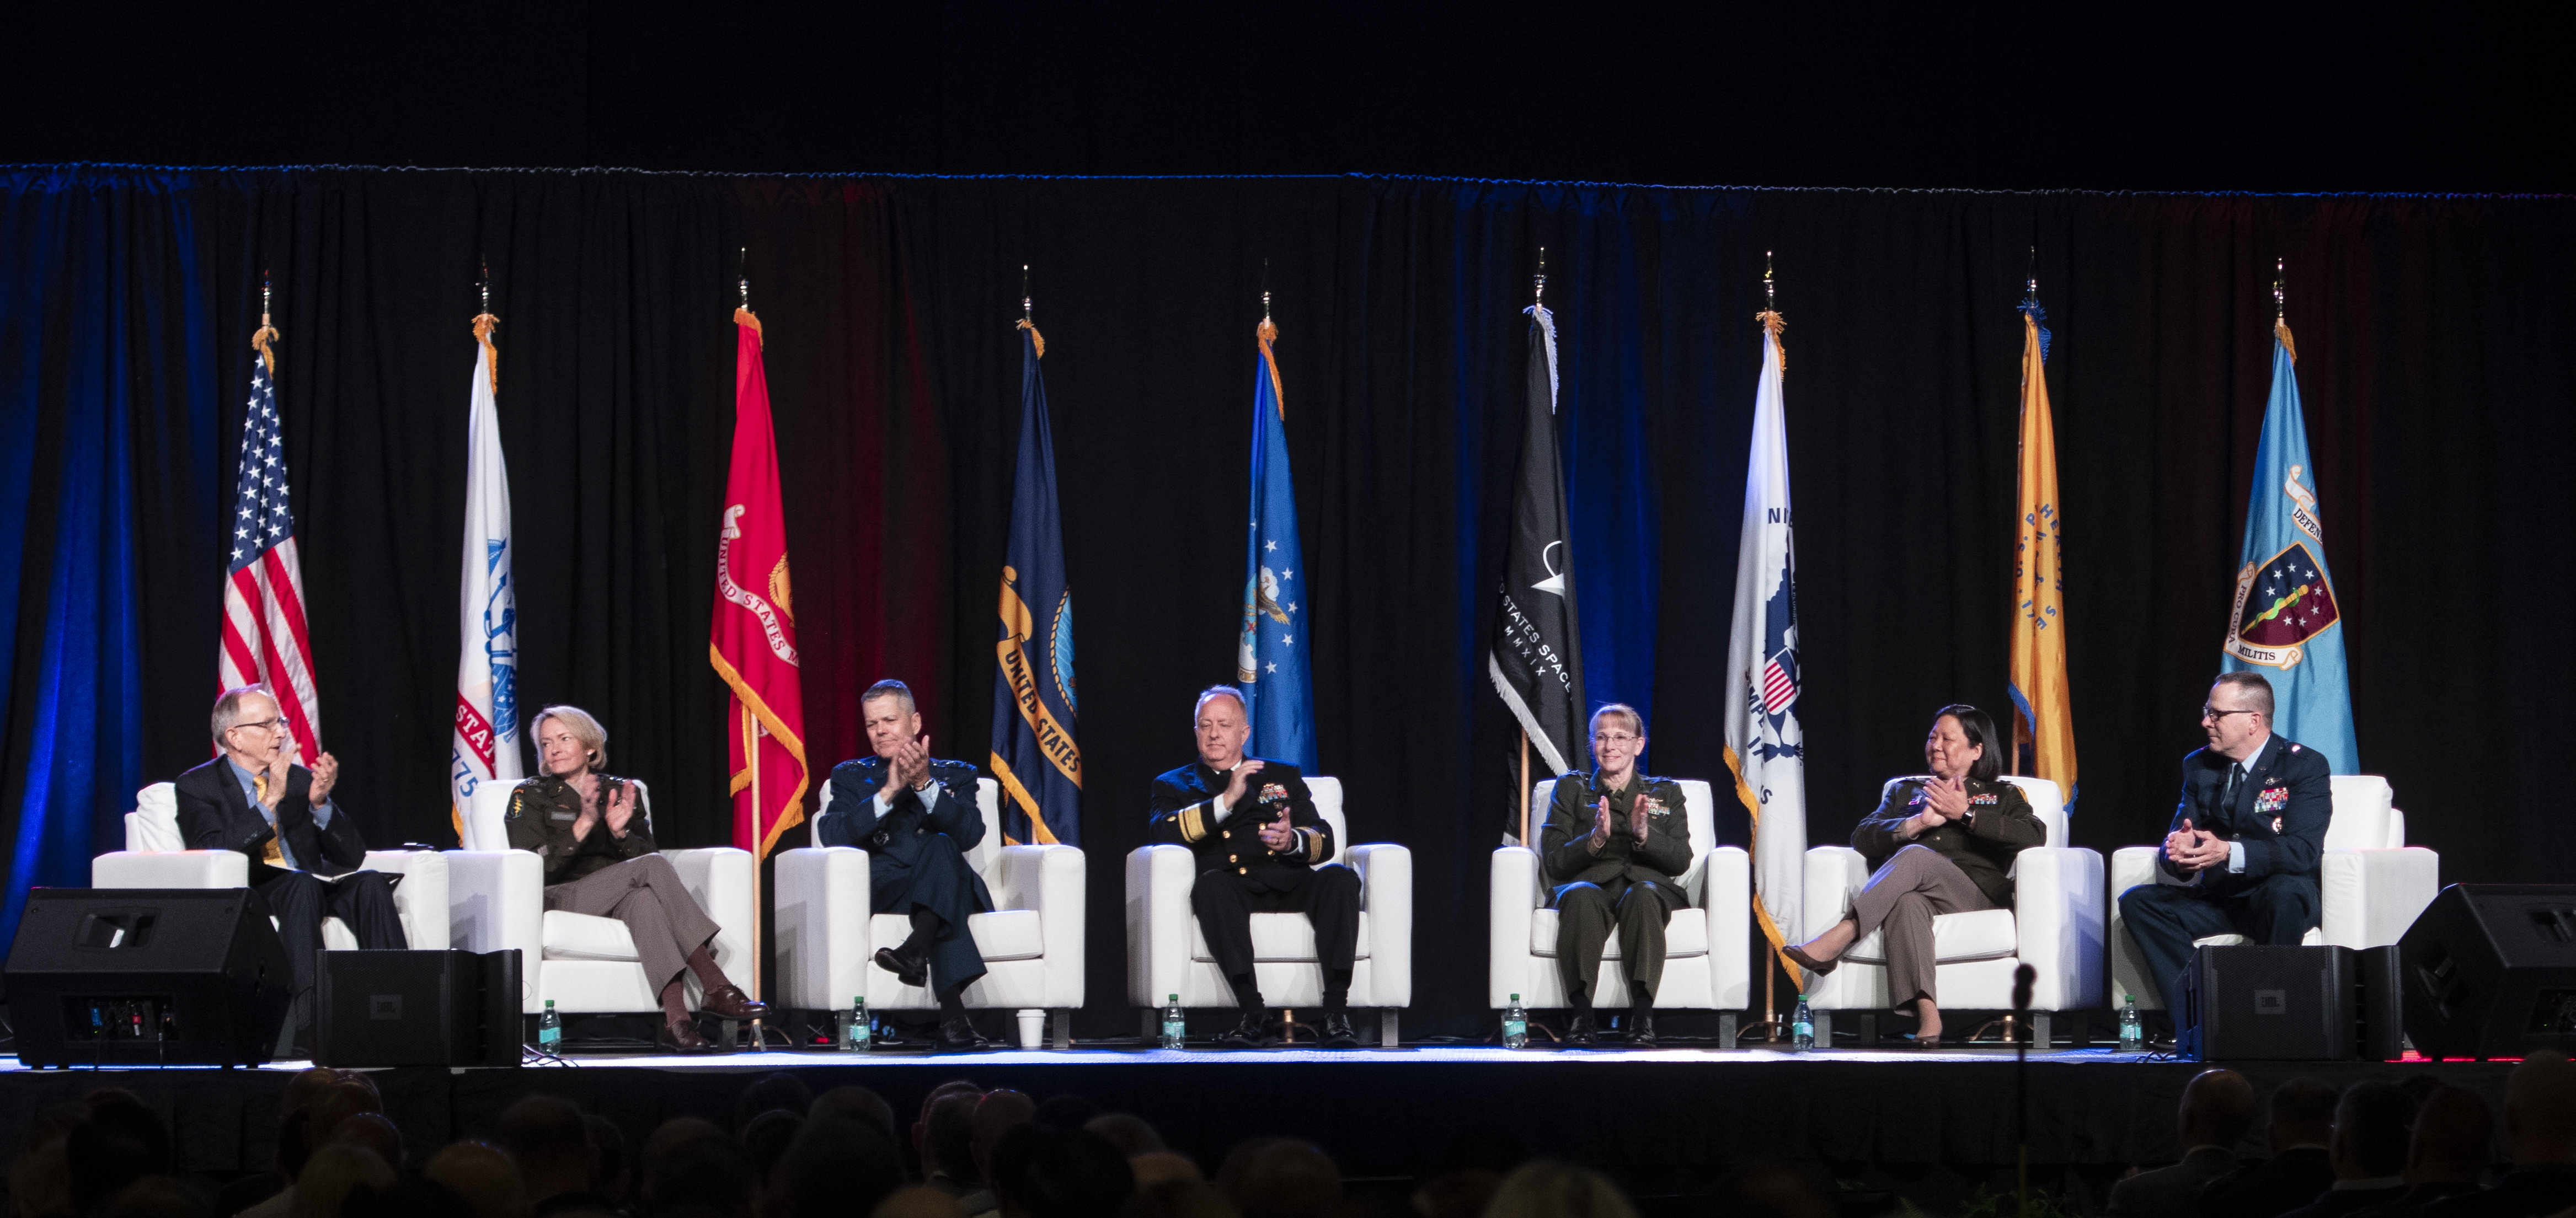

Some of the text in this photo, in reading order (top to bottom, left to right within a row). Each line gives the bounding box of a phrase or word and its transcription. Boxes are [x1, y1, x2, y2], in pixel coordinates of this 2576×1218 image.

[720, 537, 785, 651] UNITED STATES
[1503, 595, 1571, 693] STATES SPACE
[2228, 584, 2275, 661] PRO CURA MILITIS
[1005, 650, 1081, 772] UNITED STATES
